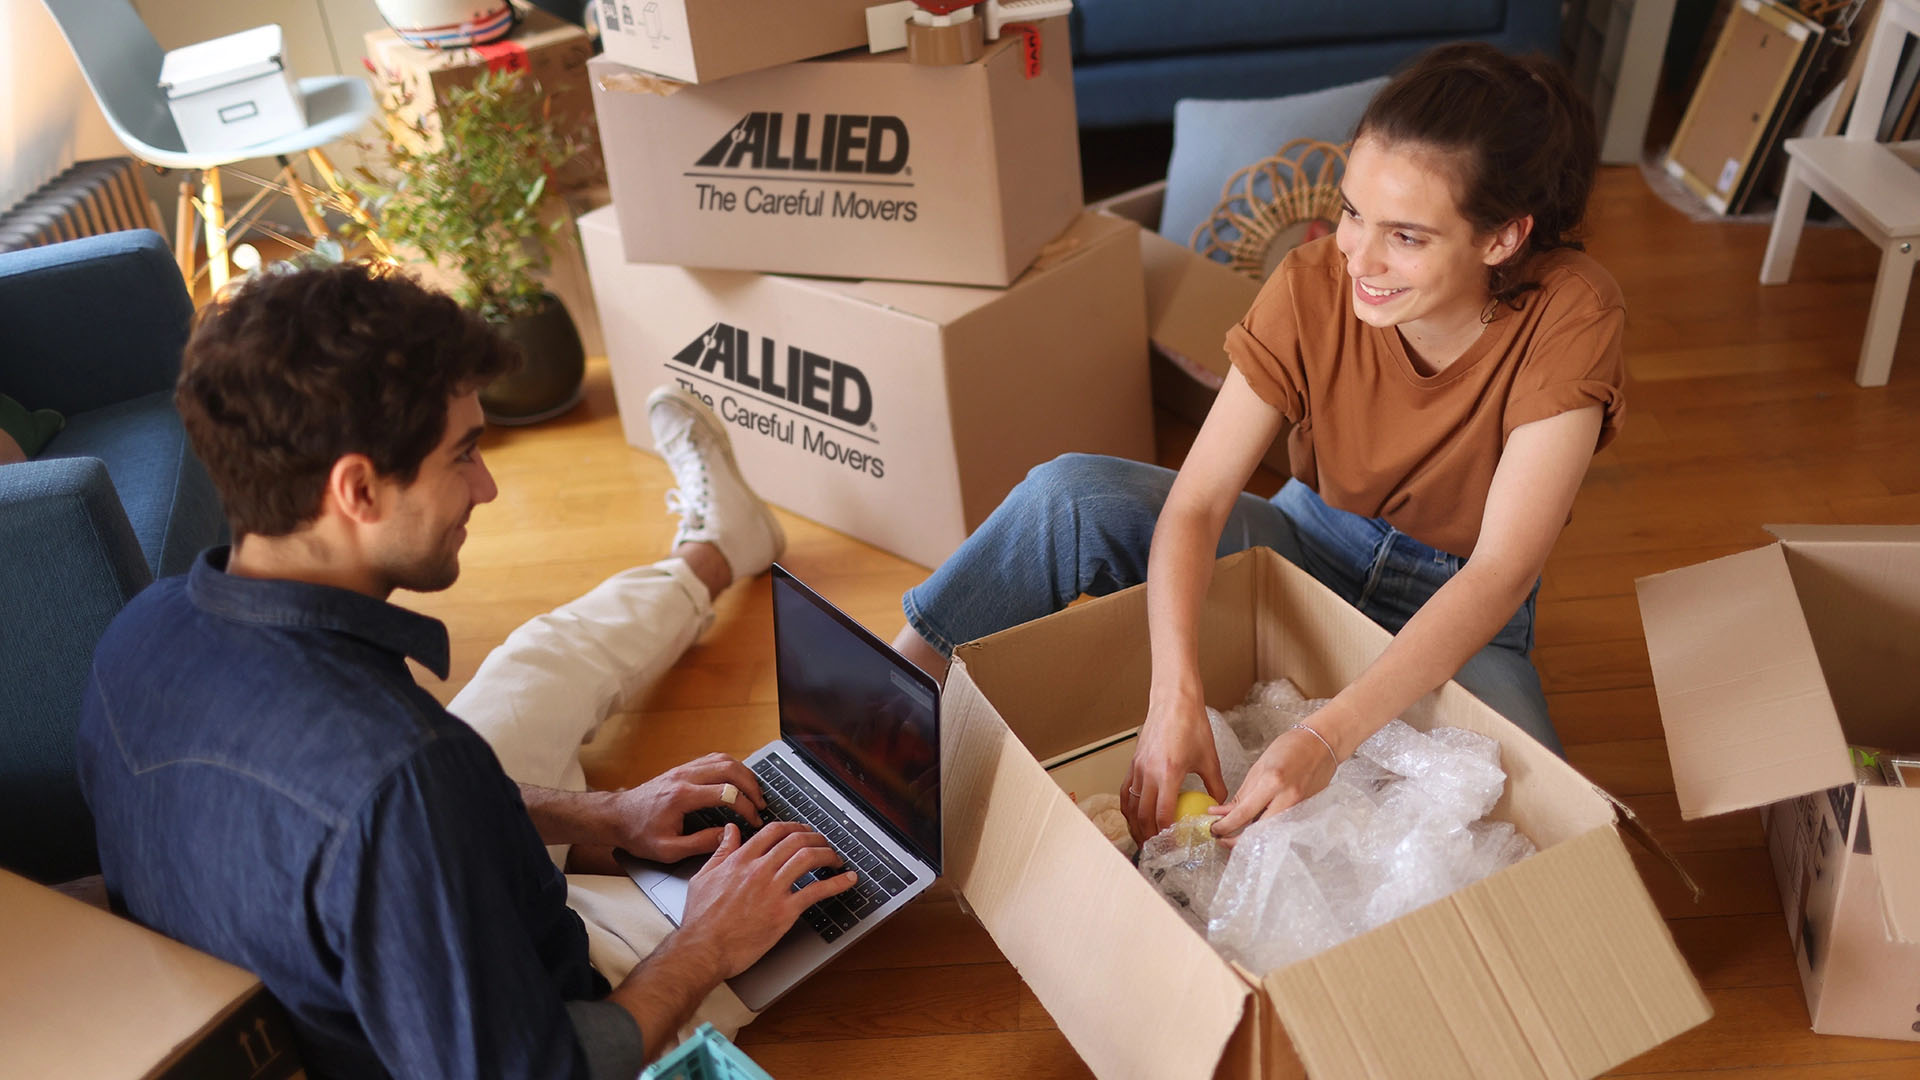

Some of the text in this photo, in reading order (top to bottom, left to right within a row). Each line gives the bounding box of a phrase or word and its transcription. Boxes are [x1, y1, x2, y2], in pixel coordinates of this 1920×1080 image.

[694, 112, 910, 175] ALLIED
[696, 183, 917, 222] The Careful Movers
[672, 322, 873, 427] ALLIED
[721, 396, 794, 445] Careful
[803, 425, 885, 479] Movers
